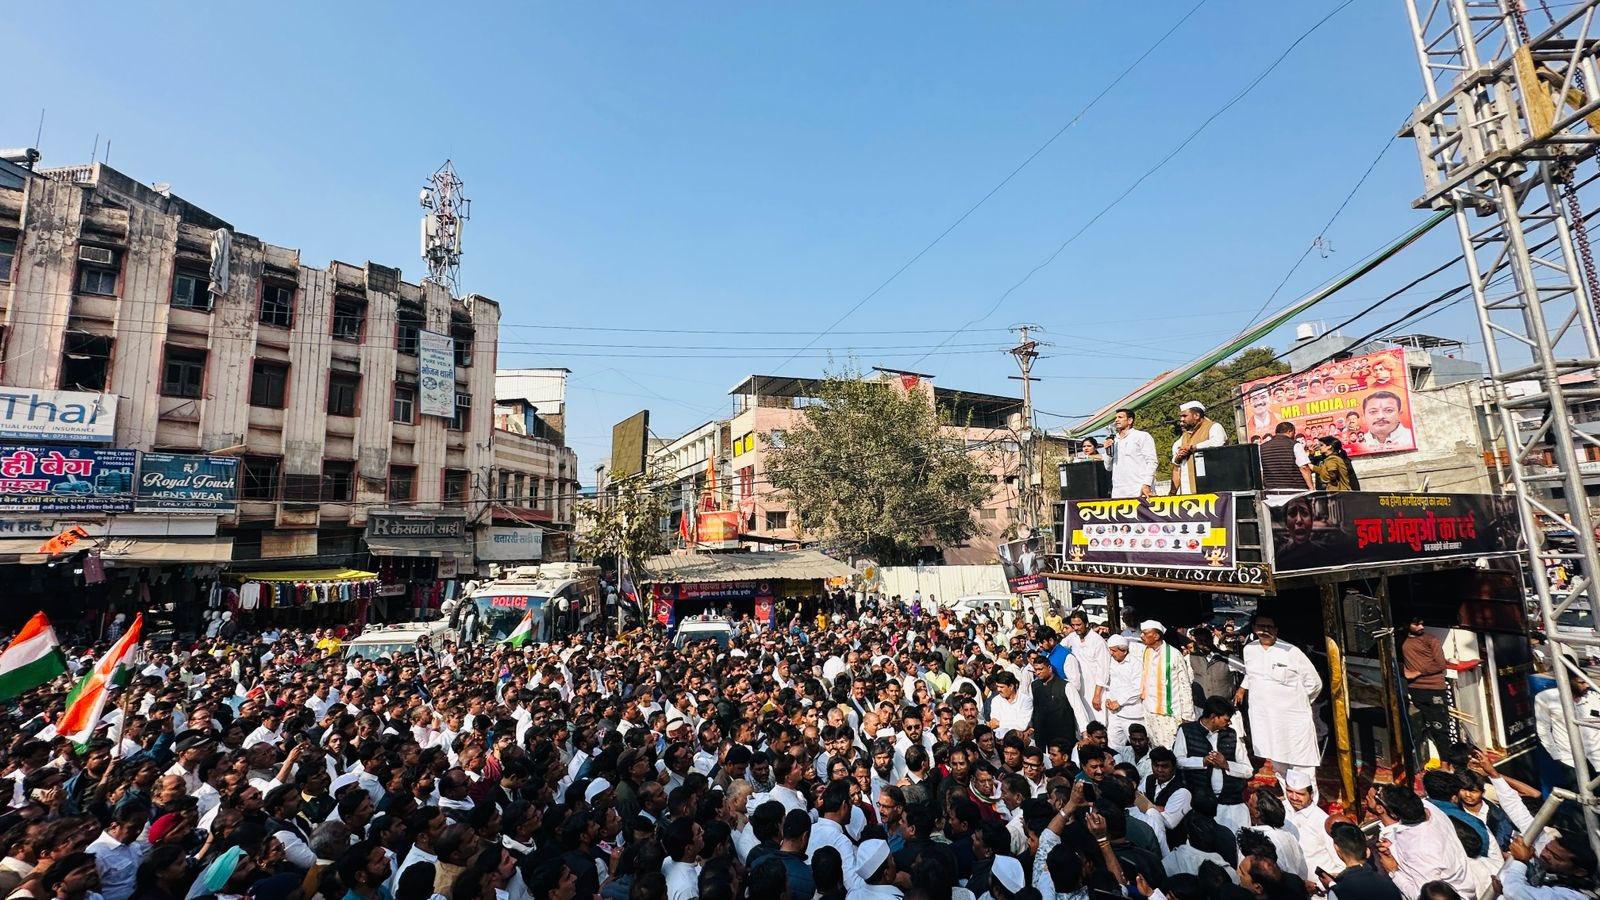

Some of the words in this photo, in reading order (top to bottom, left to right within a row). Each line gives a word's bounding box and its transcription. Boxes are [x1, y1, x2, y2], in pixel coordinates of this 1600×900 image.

[1280, 404, 1304, 419] MR.
[1306, 397, 1344, 415] INDIA
[142, 472, 191, 489] Royal
[192, 474, 235, 489] Touch
[152, 490, 186, 499] MENS
[190, 491, 224, 501] WEAR
[1077, 498, 1142, 522] न्याय
[1147, 493, 1220, 519] यात्रा
[373, 517, 389, 535] R
[437, 521, 460, 536] साड़ी
[1354, 518, 1383, 549] इन
[1438, 517, 1457, 540] का
[1457, 509, 1476, 539] दर्द
[492, 595, 528, 609] POLICE
